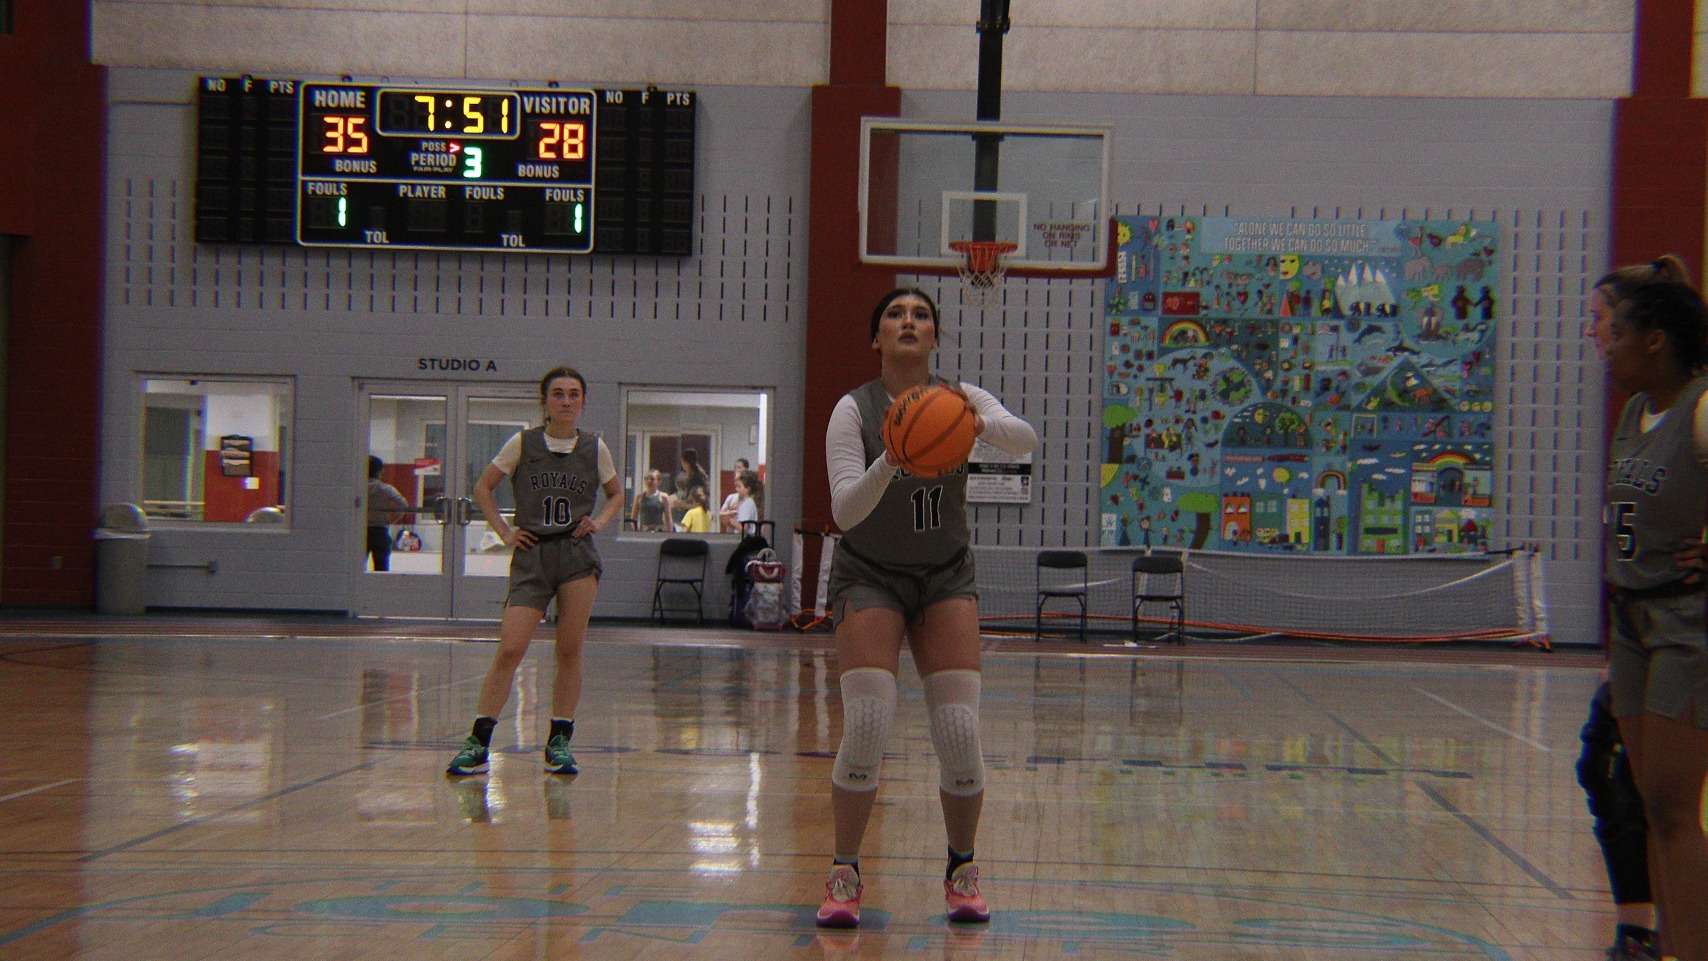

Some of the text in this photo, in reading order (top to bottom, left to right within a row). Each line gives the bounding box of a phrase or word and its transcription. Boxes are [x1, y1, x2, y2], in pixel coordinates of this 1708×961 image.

[206, 78, 294, 94] NO F PTS
[313, 90, 366, 109] HOME
[523, 96, 591, 115] VISITOR
[606, 91, 690, 106] NO F PTS
[413, 95, 509, 134] 7:51
[322, 116, 369, 154] 35
[538, 122, 585, 160] 28
[421, 141, 447, 152] POSS
[334, 158, 377, 174] BONUS
[410, 153, 457, 167] PERIOD
[462, 146, 484, 179] 3
[517, 164, 560, 179] BONUS
[307, 182, 348, 196] FOULS
[399, 185, 446, 199] PLAYER
[465, 186, 505, 200] FOULS
[545, 188, 585, 202] FOULS
[337, 196, 347, 228] 1
[573, 202, 584, 234] 1
[1033, 223, 1090, 232] NO HANGING
[1269, 223, 1284, 236] WE
[1286, 223, 1306, 236] CAN
[1309, 223, 1321, 237] DO
[1323, 224, 1337, 237] SO
[365, 230, 390, 244] TOL
[501, 233, 526, 248] TOL
[1224, 237, 1269, 251] TOGETHER
[1271, 238, 1285, 251] WE
[1288, 239, 1308, 252] CAN
[1310, 239, 1322, 252] DO
[1325, 239, 1337, 253] SO
[418, 358, 498, 372] STUDIO A
[529, 471, 589, 495] ROYALS
[542, 495, 572, 527] 10
[910, 485, 944, 533] 11
